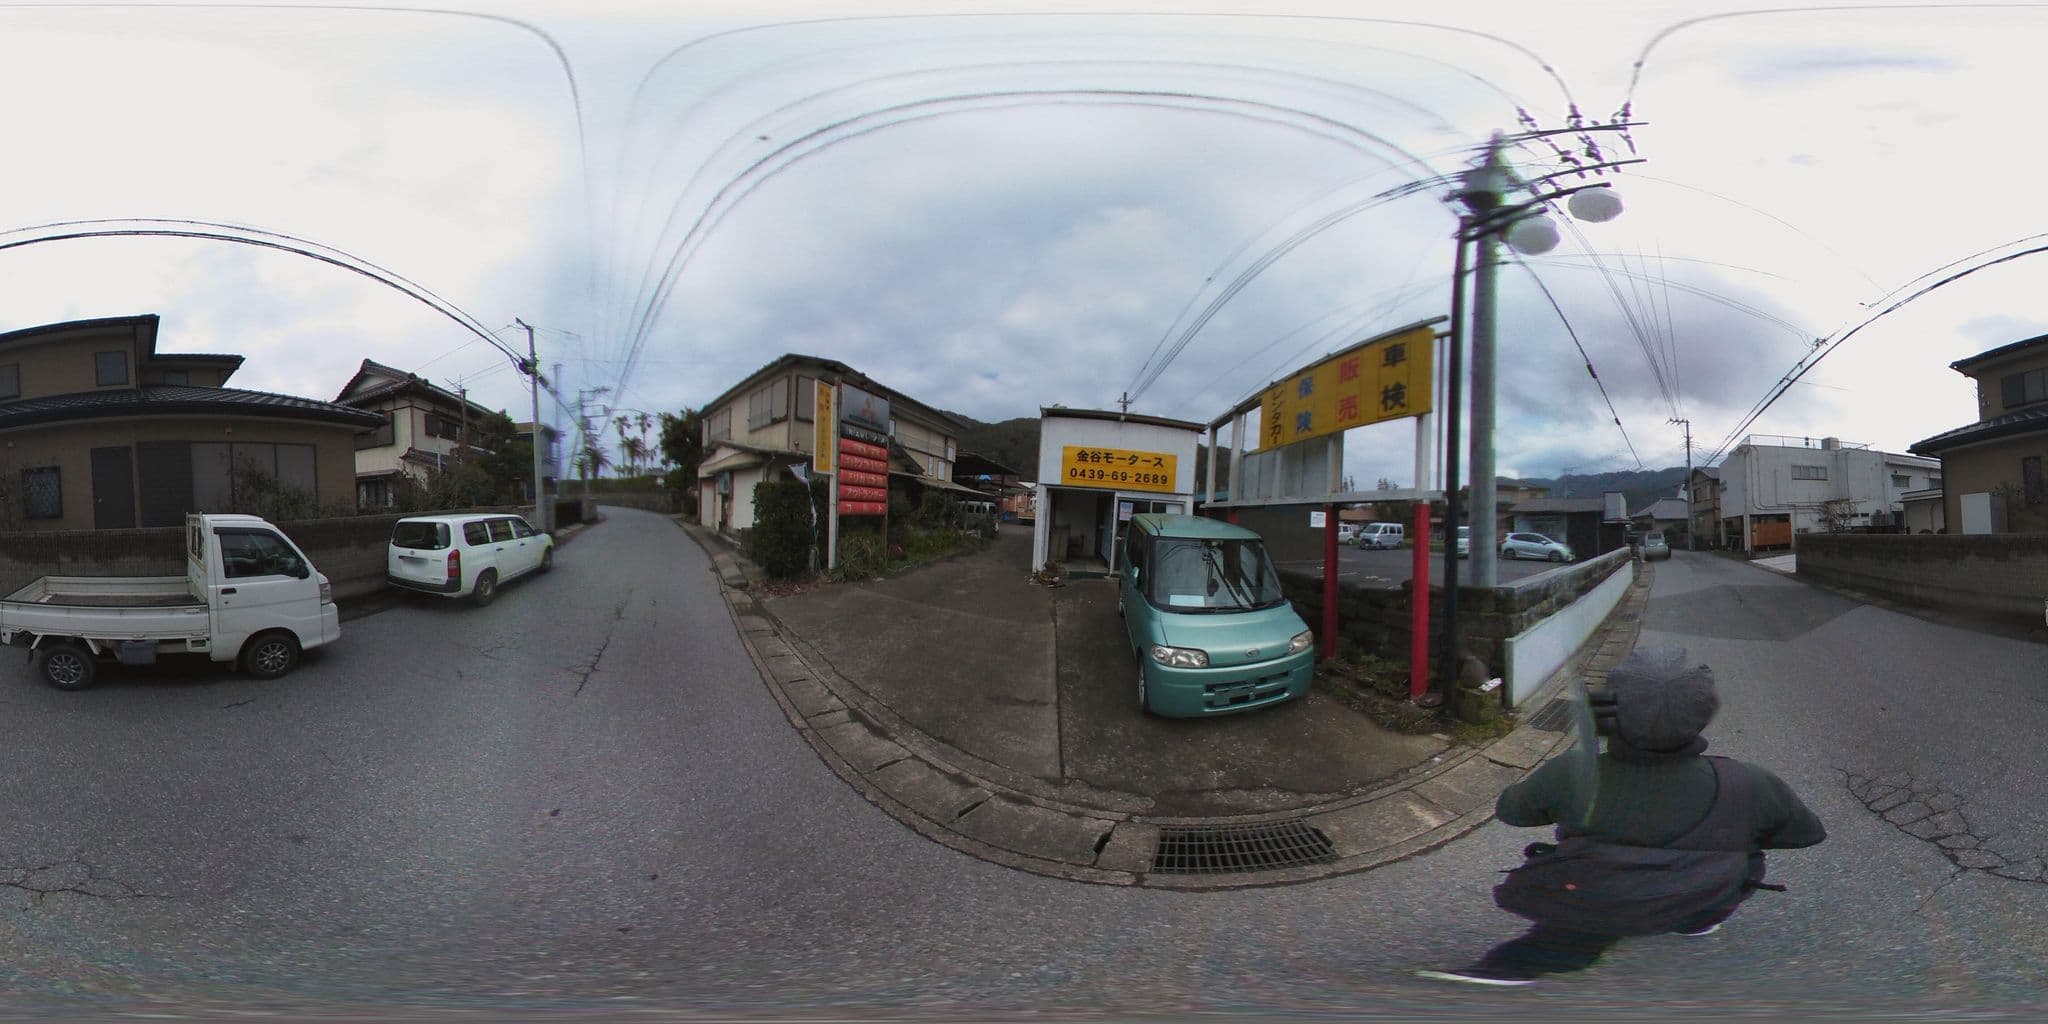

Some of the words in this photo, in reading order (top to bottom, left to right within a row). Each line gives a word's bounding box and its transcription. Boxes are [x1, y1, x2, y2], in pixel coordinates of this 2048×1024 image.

[1338, 357, 1360, 422] 販売
[1382, 342, 1408, 411] 車検
[1070, 468, 1168, 485] 0439-69-2689
[1077, 450, 1164, 468] 金谷モータース
